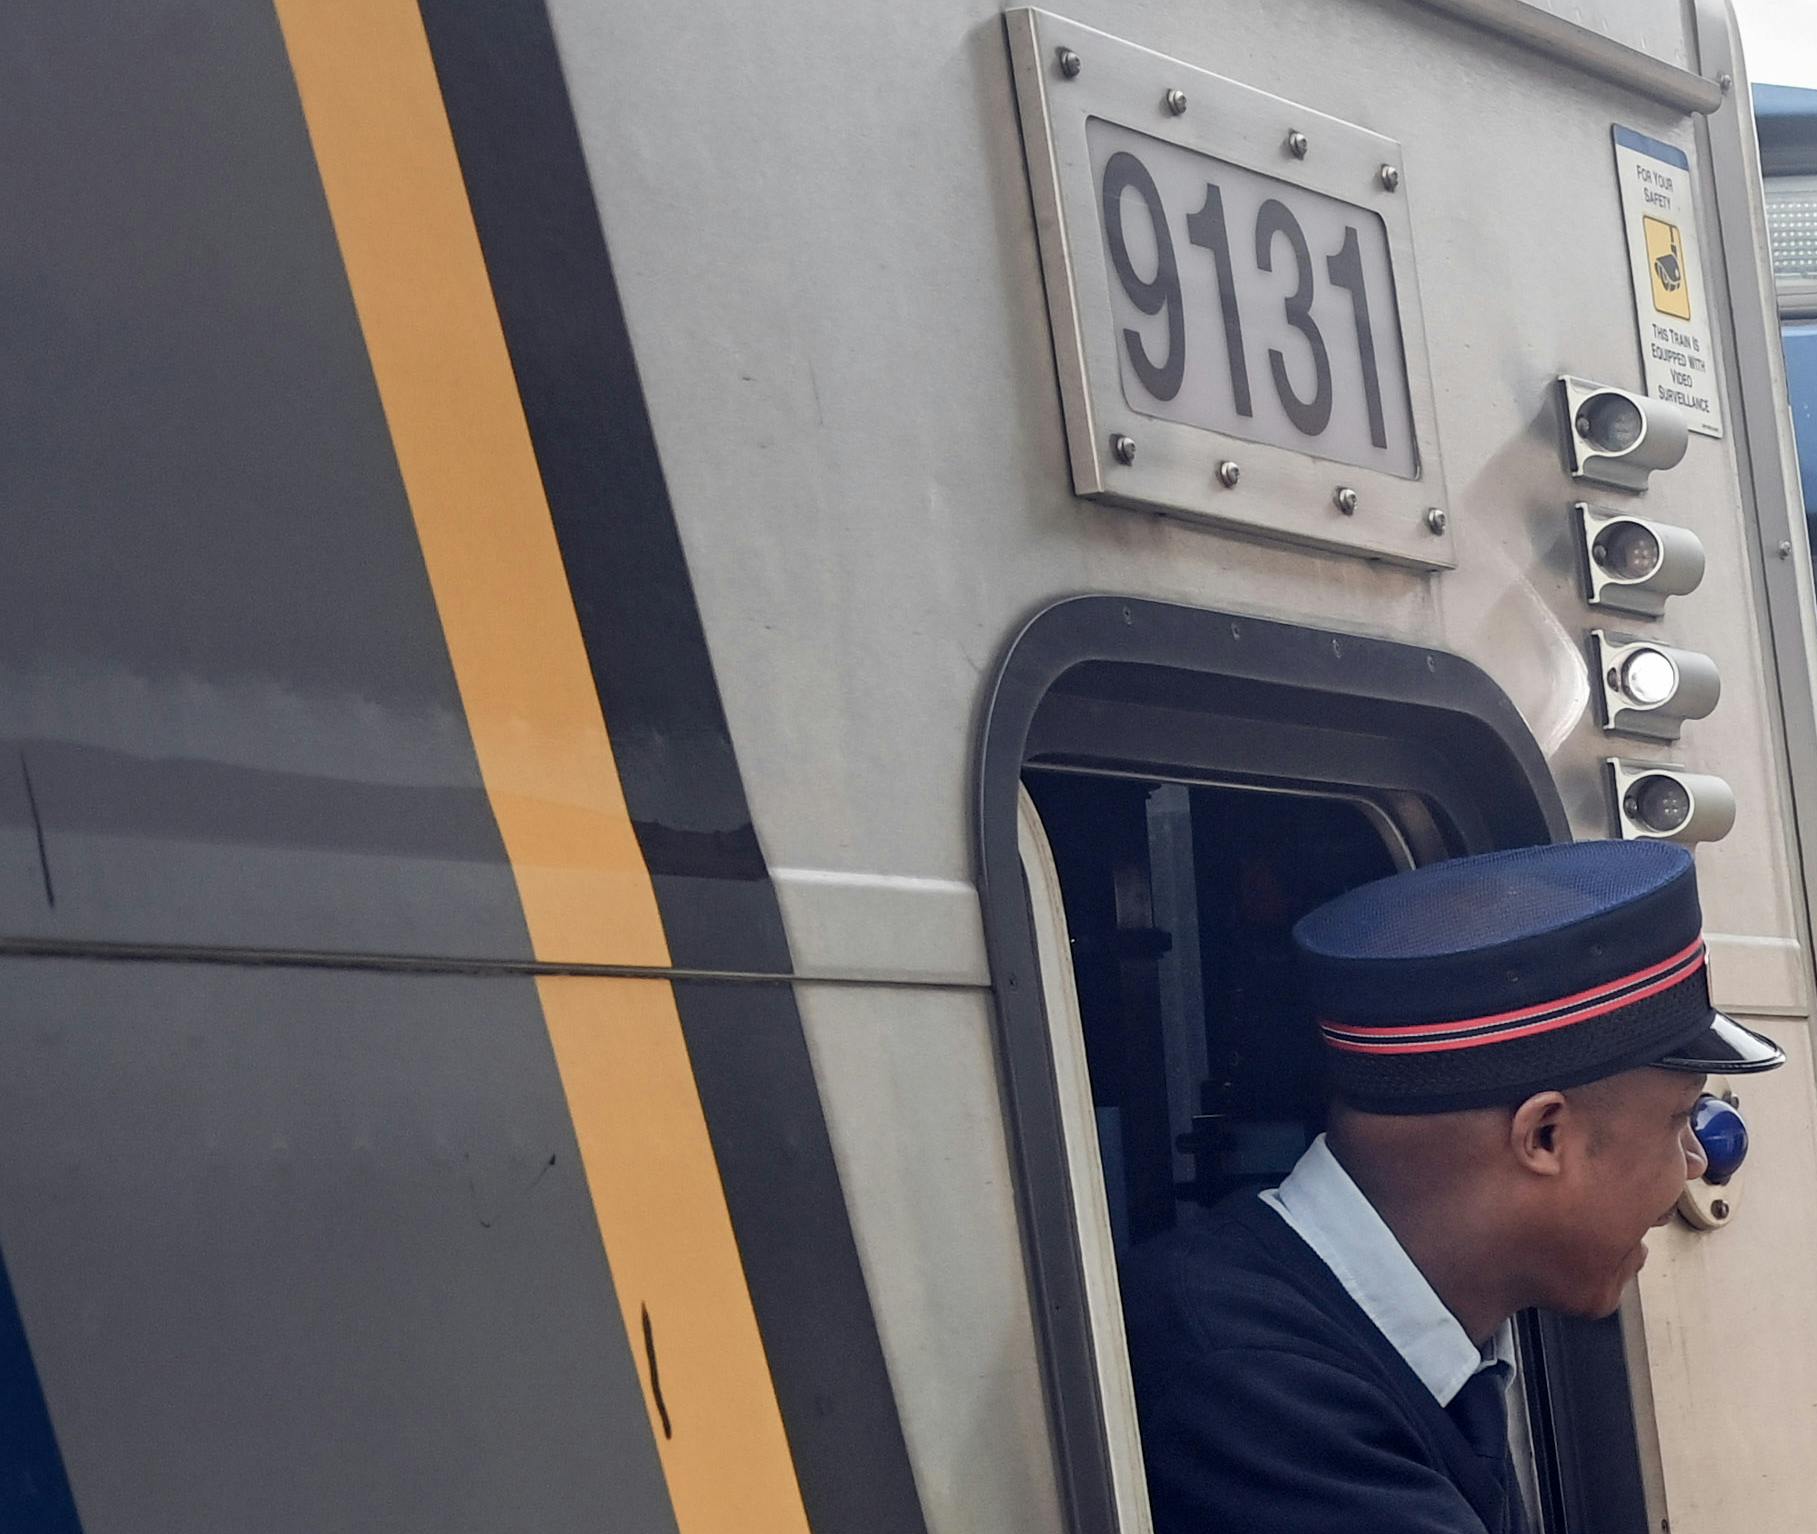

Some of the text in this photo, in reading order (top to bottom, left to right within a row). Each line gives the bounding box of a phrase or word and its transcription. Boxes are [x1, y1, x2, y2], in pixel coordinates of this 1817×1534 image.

[1636, 164, 1674, 192] FOR YOUR
[1643, 186, 1671, 210] SAFETY
[1102, 150, 1389, 451] 9131
[1652, 323, 1700, 353] THIS TRAIN IS
[1651, 342, 1706, 374] EQUIPPED WITH
[1670, 368, 1693, 388] VIDEO
[1657, 384, 1710, 413] SURVEILLANCE
